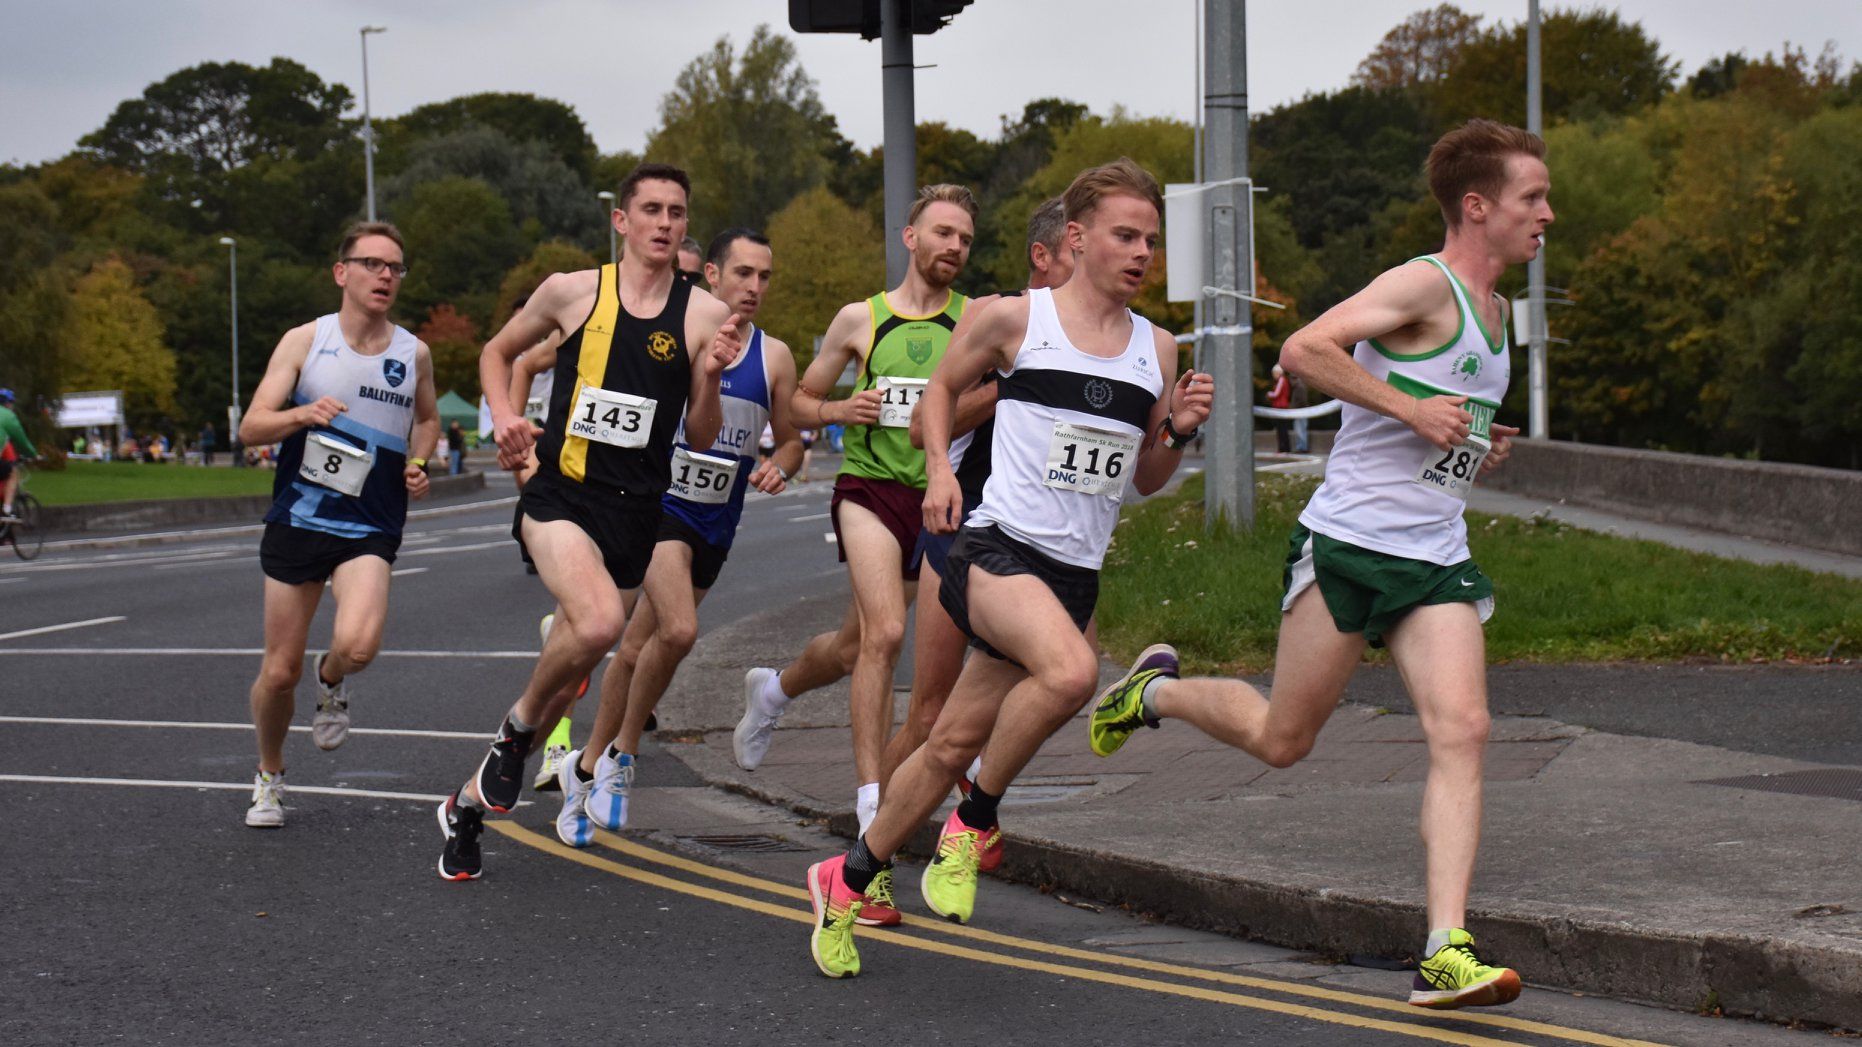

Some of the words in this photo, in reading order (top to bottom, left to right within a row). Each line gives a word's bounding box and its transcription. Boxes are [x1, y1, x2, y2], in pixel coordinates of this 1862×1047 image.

[359, 385, 405, 407] BALLYFIN
[573, 422, 596, 434] DNG
[582, 402, 642, 433] 143
[1054, 430, 1098, 444] Rathfarnham
[324, 454, 342, 474] 8
[1060, 443, 1124, 478] 116
[1435, 447, 1479, 482] 281
[677, 464, 729, 491] 150
[1048, 469, 1077, 484] DNG
[1422, 469, 1447, 486] DNG
